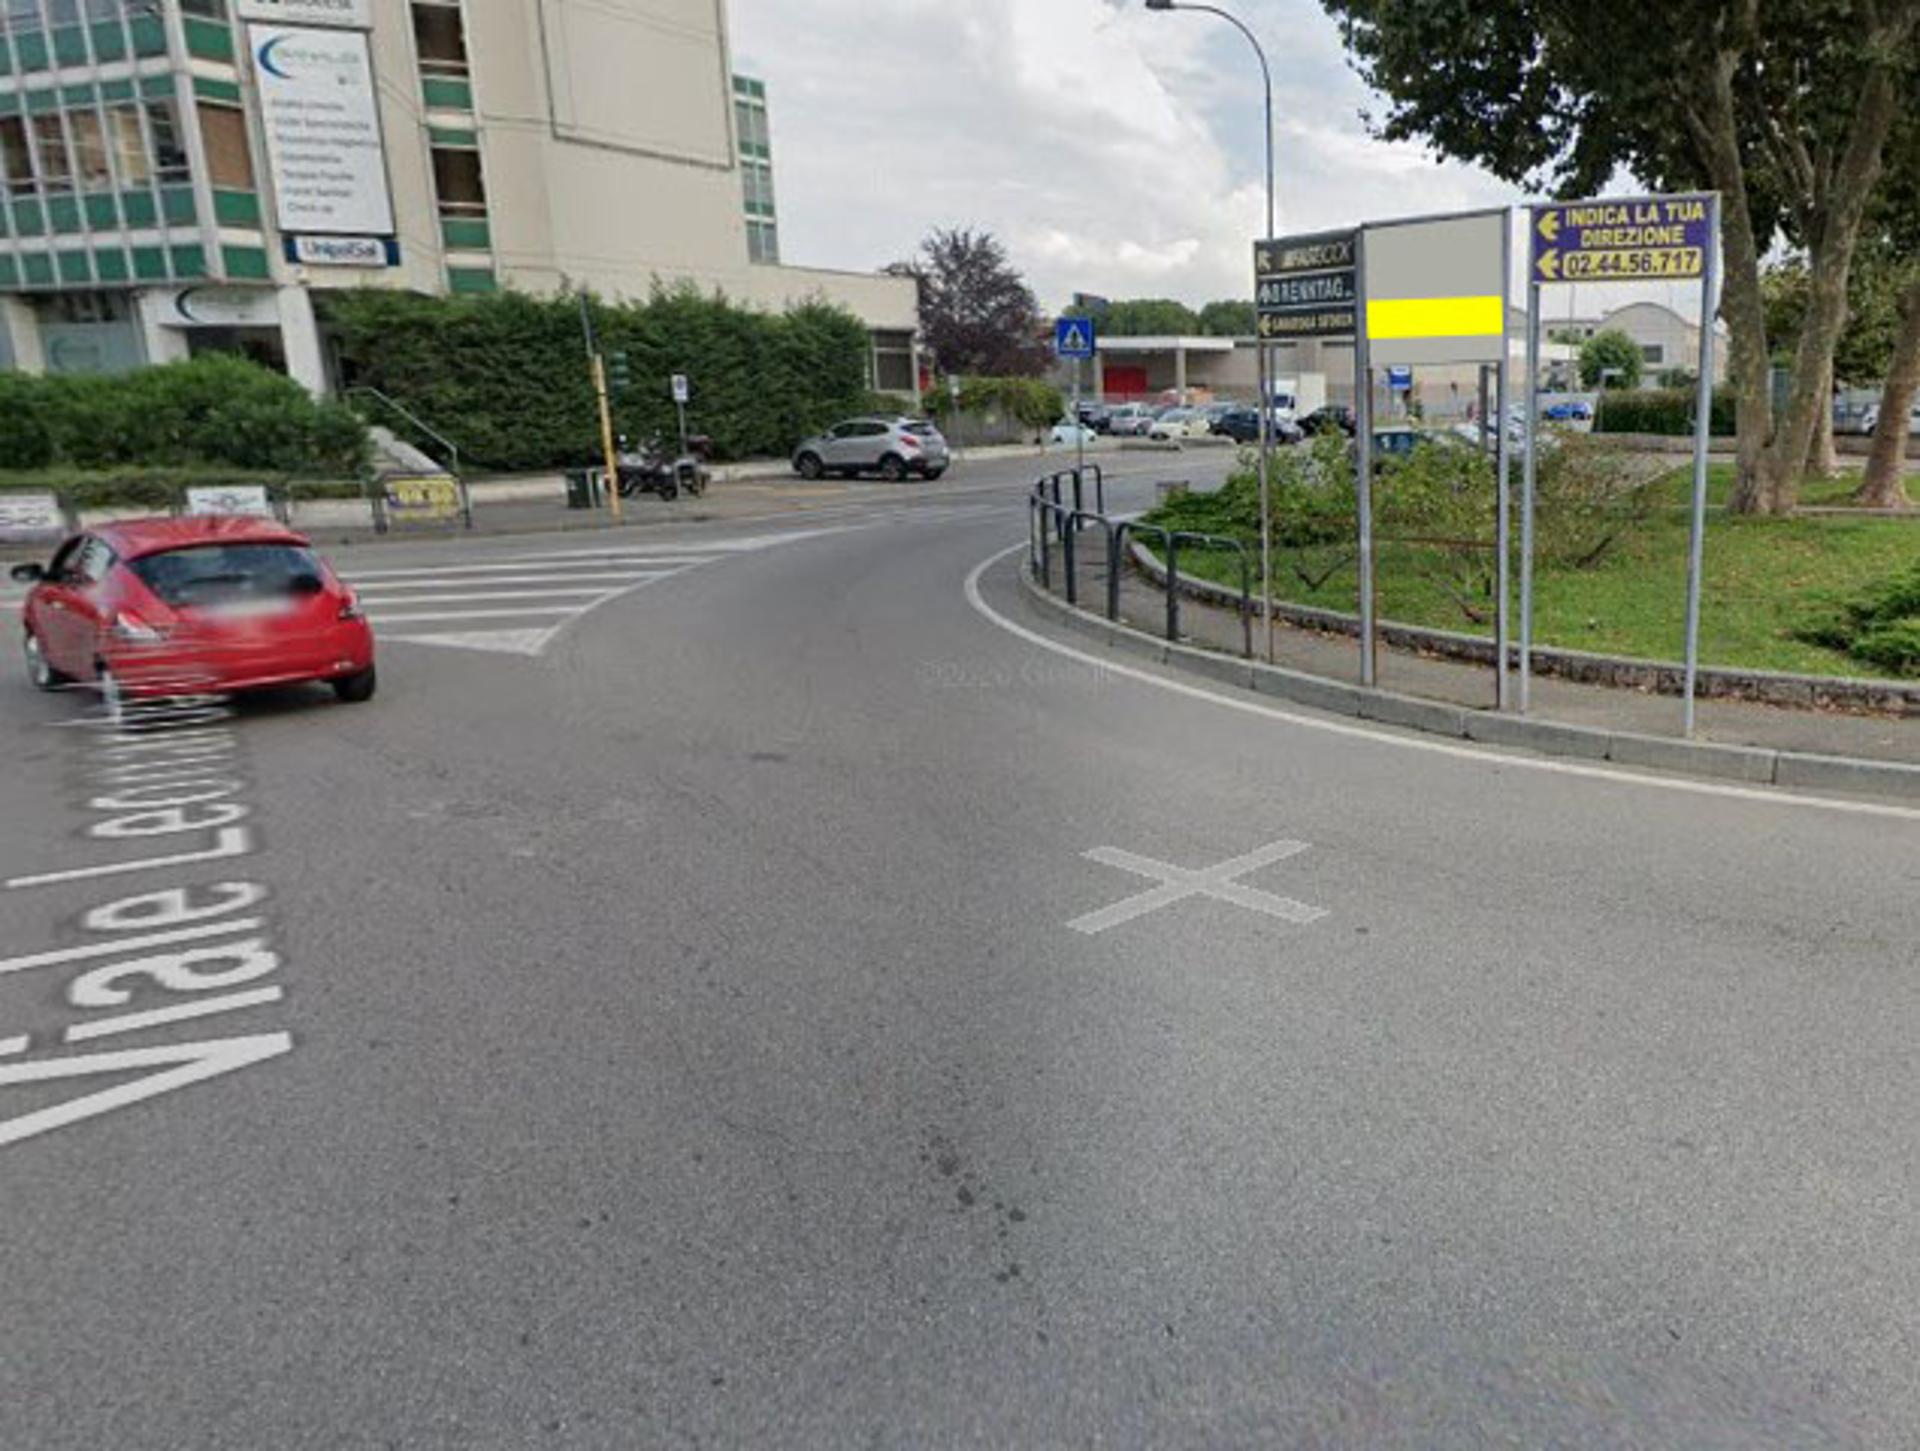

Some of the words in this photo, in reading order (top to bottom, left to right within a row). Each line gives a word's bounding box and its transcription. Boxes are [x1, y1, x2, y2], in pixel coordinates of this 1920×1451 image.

[1566, 205, 1629, 227] INDICA
[1635, 204, 1660, 223] LA
[1666, 202, 1706, 221] TUA
[1580, 225, 1685, 248] DIREZIONE
[1568, 250, 1698, 275] 02.44.56.717
[0, 882, 292, 1145] Viale
